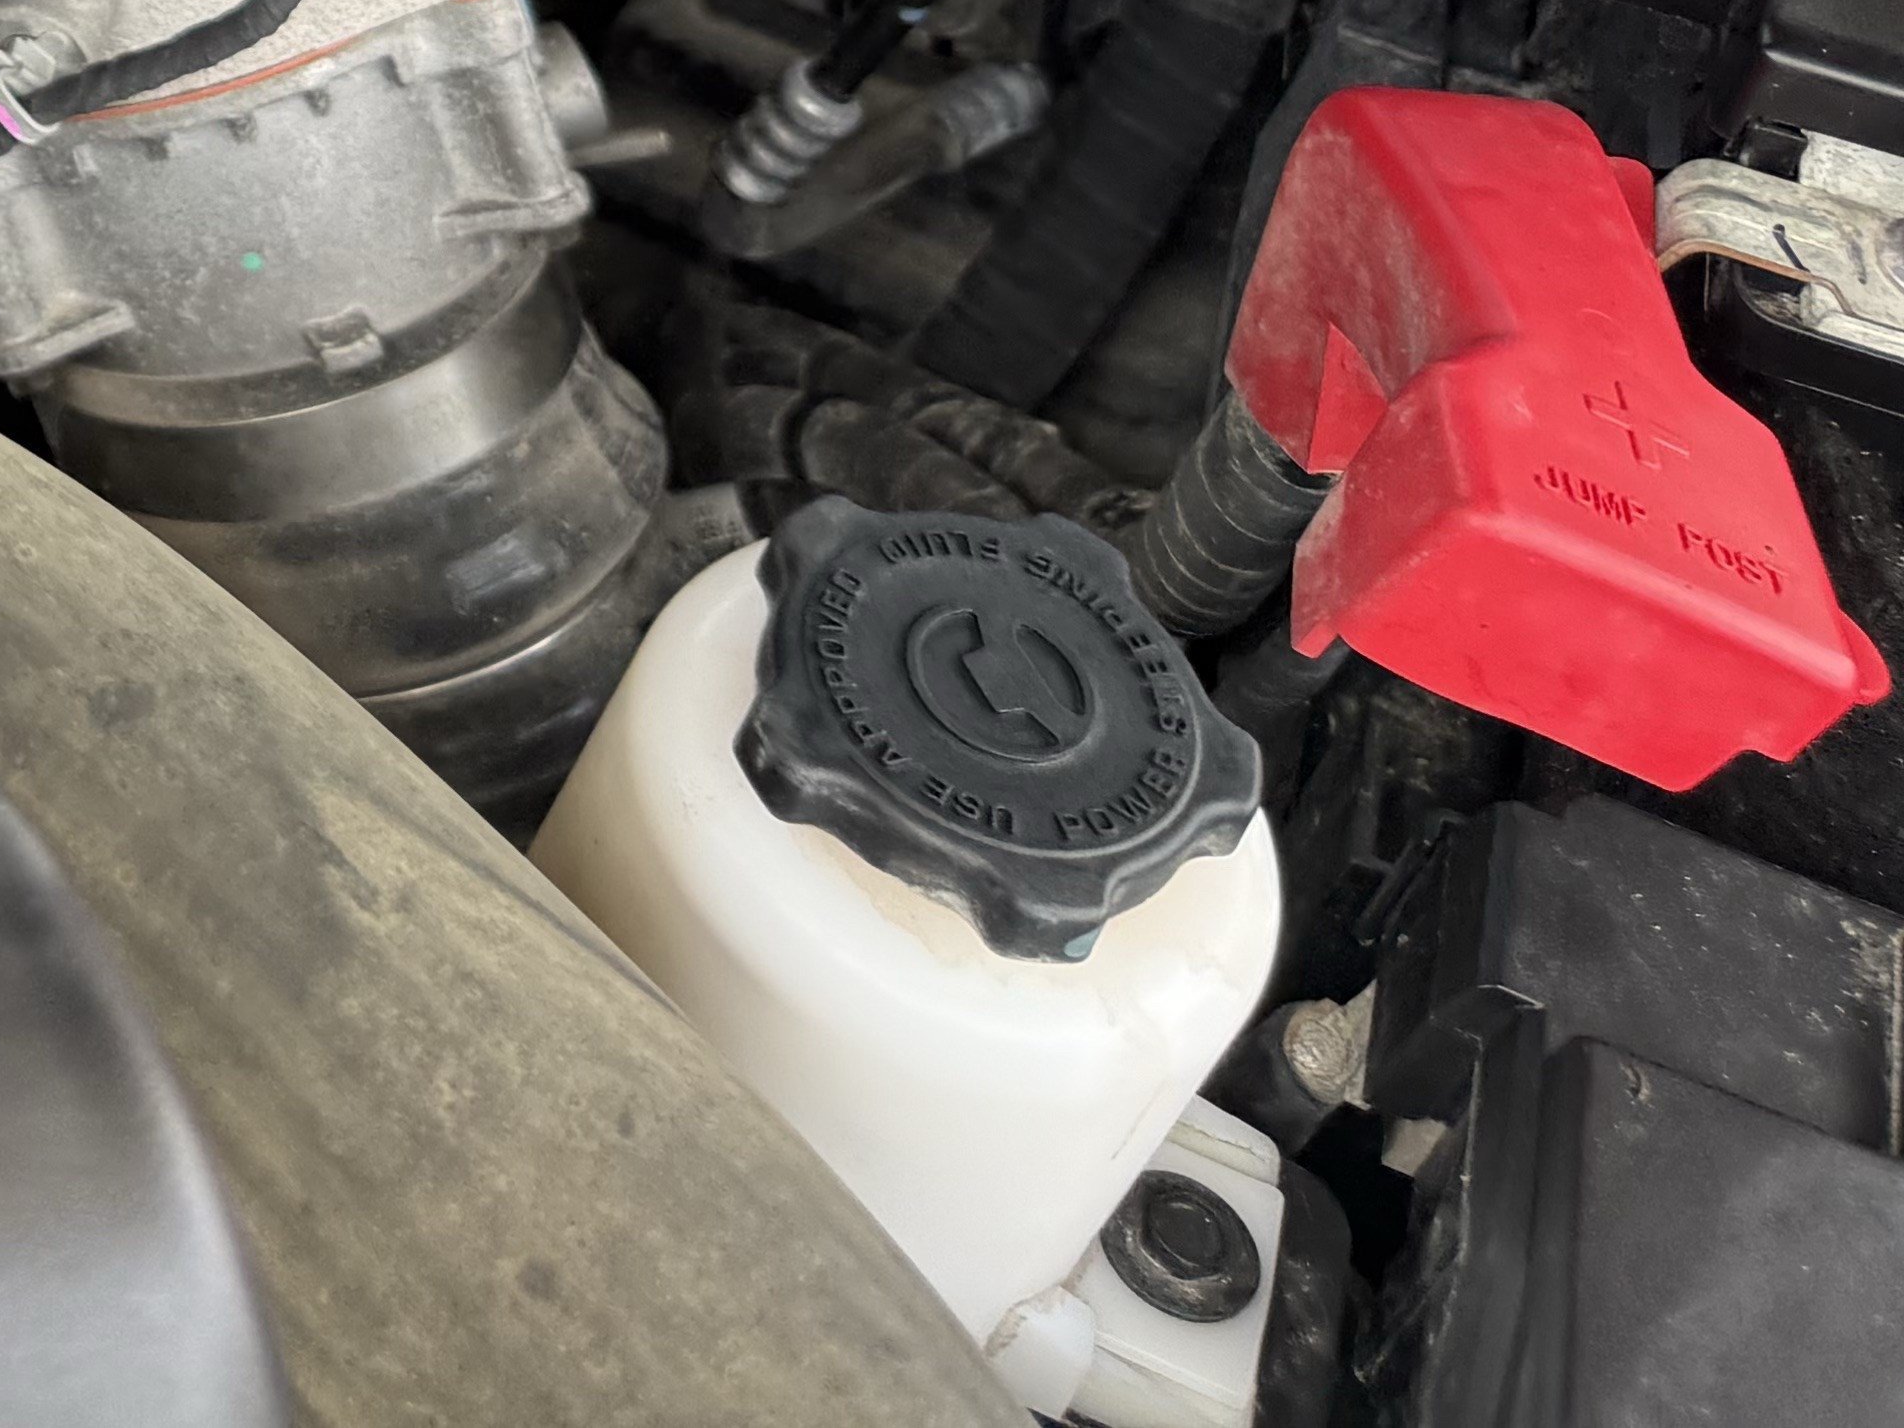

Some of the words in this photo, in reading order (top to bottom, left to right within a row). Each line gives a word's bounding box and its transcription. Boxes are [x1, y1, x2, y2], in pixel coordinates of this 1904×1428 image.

[879, 530, 1004, 565] FLUID
[1533, 464, 1647, 527] JUMP
[1676, 521, 1790, 595] POST
[818, 566, 914, 772] APPROVED
[1024, 548, 1190, 738] STEERING
[920, 776, 1016, 837] USE
[1052, 747, 1188, 842] POWER
